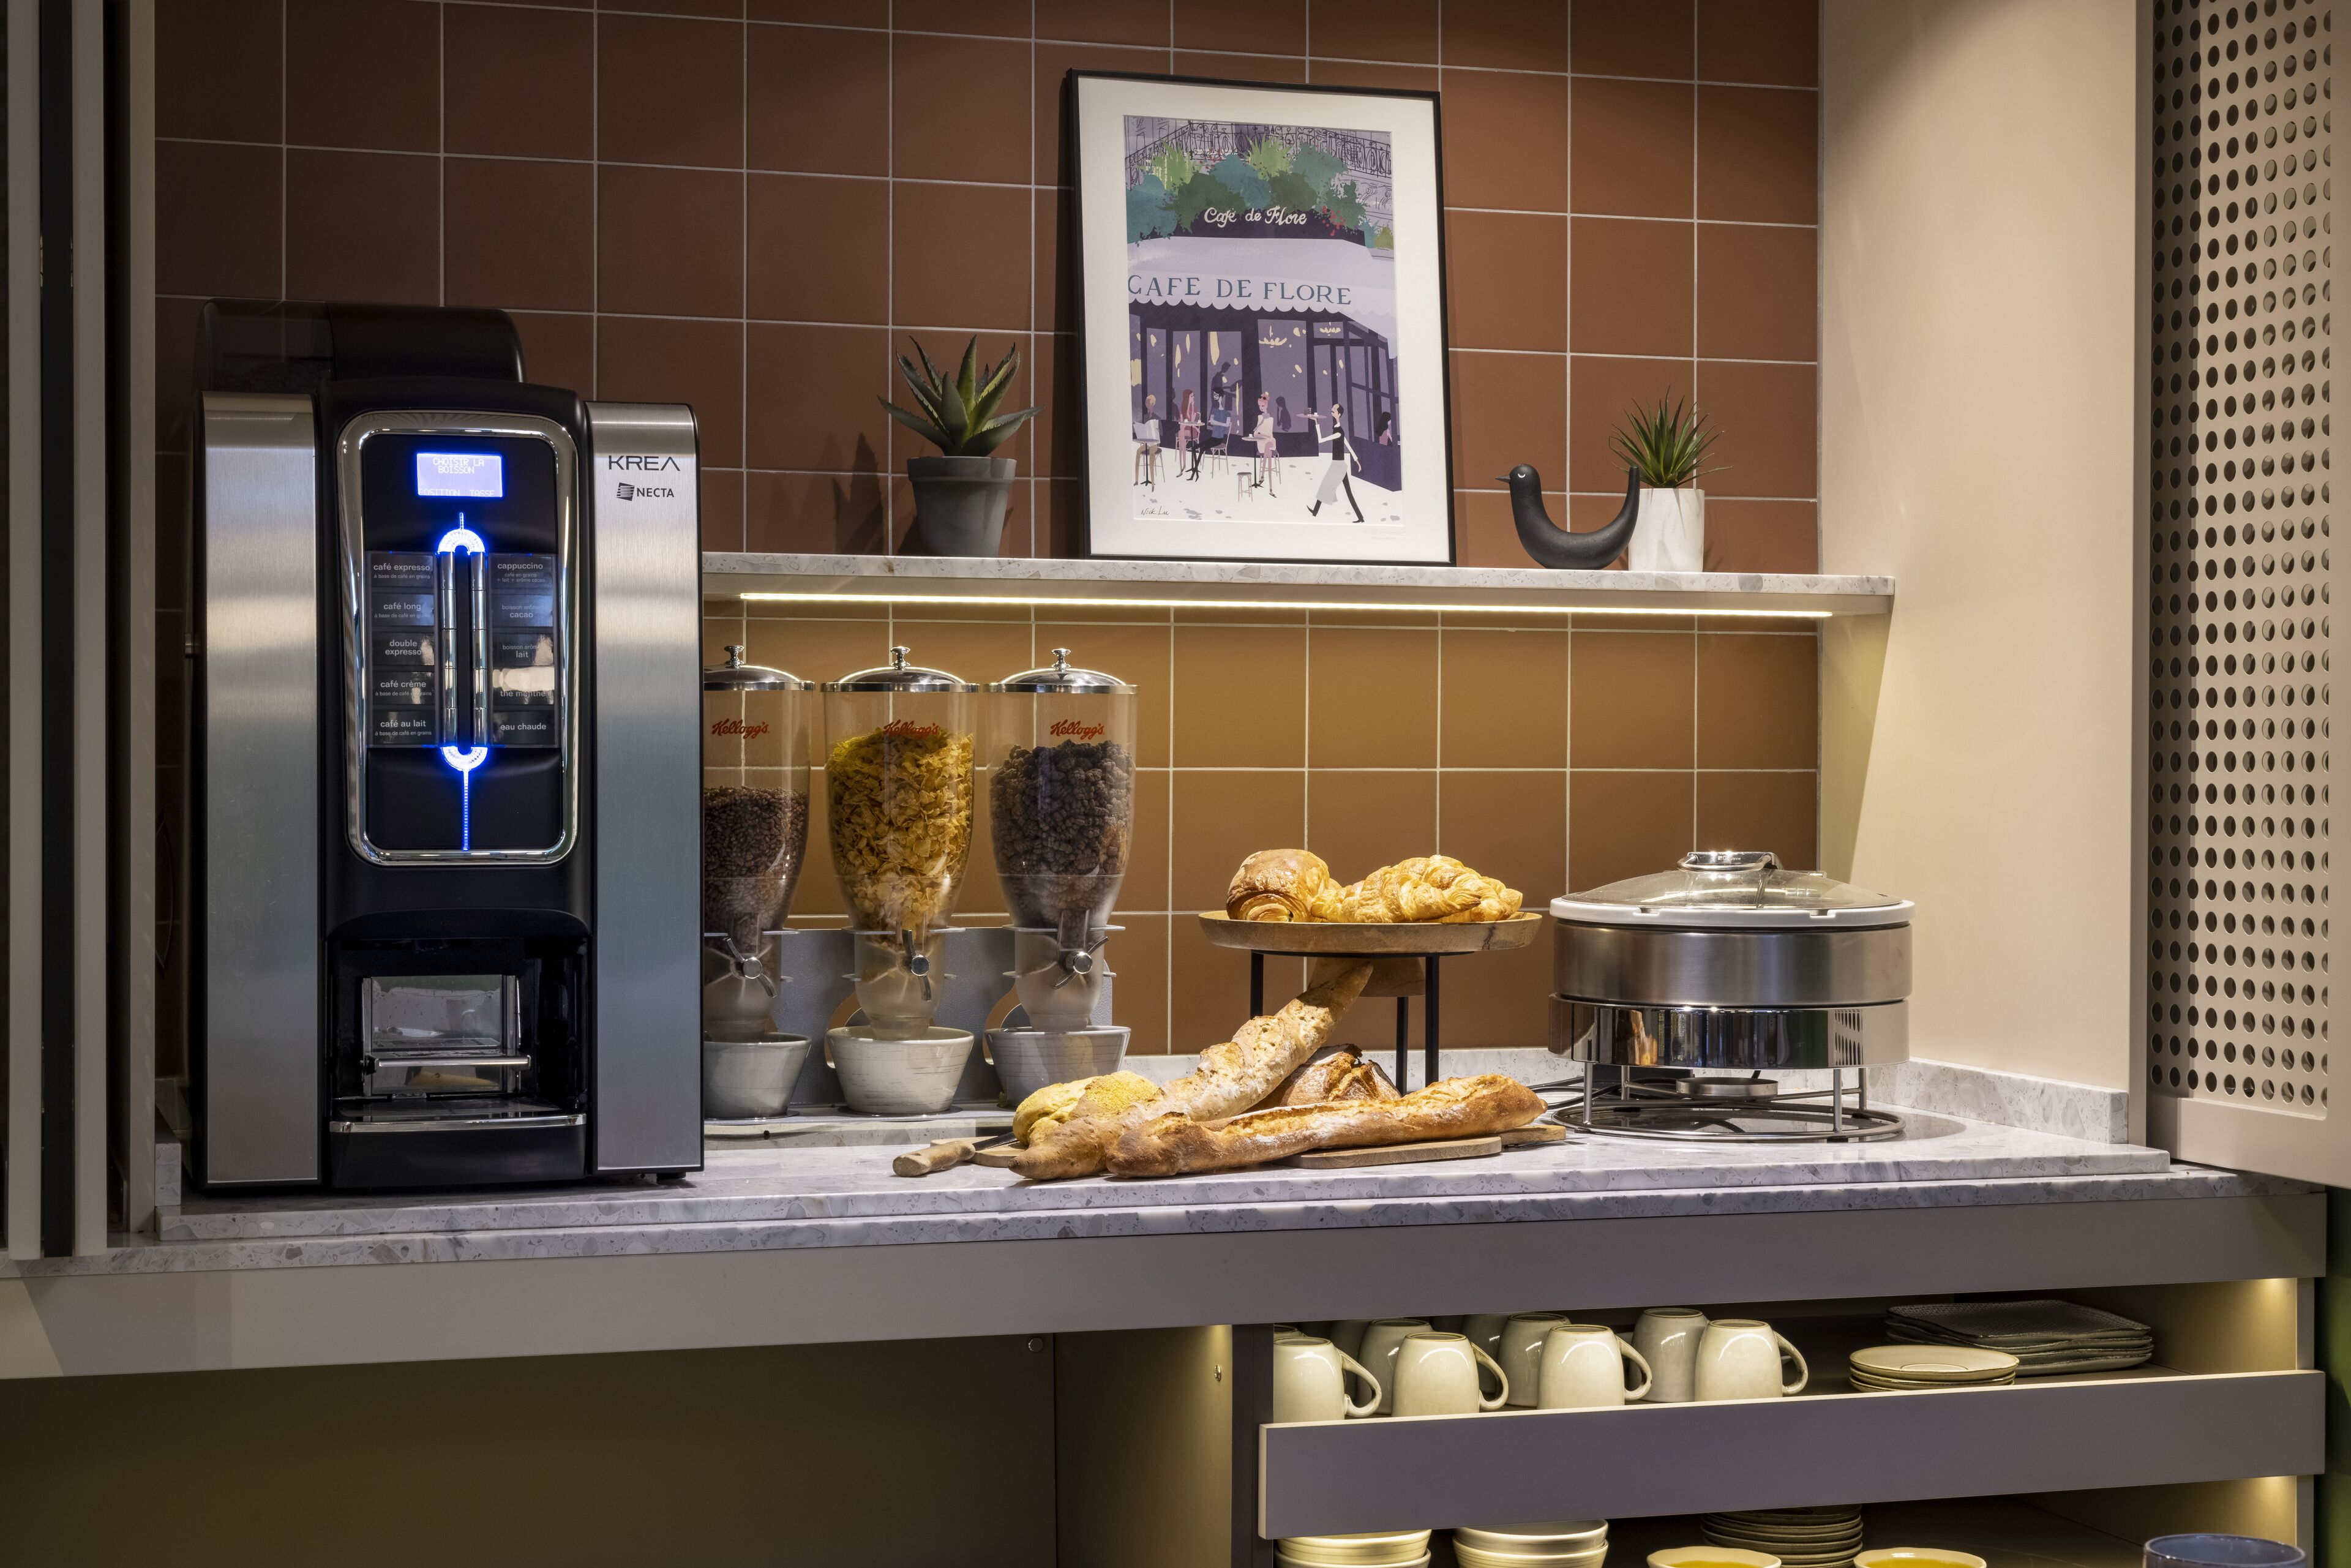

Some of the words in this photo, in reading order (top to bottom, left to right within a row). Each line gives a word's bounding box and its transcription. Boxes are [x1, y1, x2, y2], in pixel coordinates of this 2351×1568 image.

[1245, 208, 1262, 221] de
[1264, 205, 1307, 225] Flore
[1128, 275, 1201, 296] CAFE
[1217, 279, 1251, 298] DE
[1263, 282, 1351, 305] FLORE
[609, 455, 681, 471] KREA
[637, 487, 675, 497] NECTA
[403, 602, 422, 612] long
[711, 718, 769, 740] Kellogg's
[1050, 719, 1105, 740] Kellogg's
